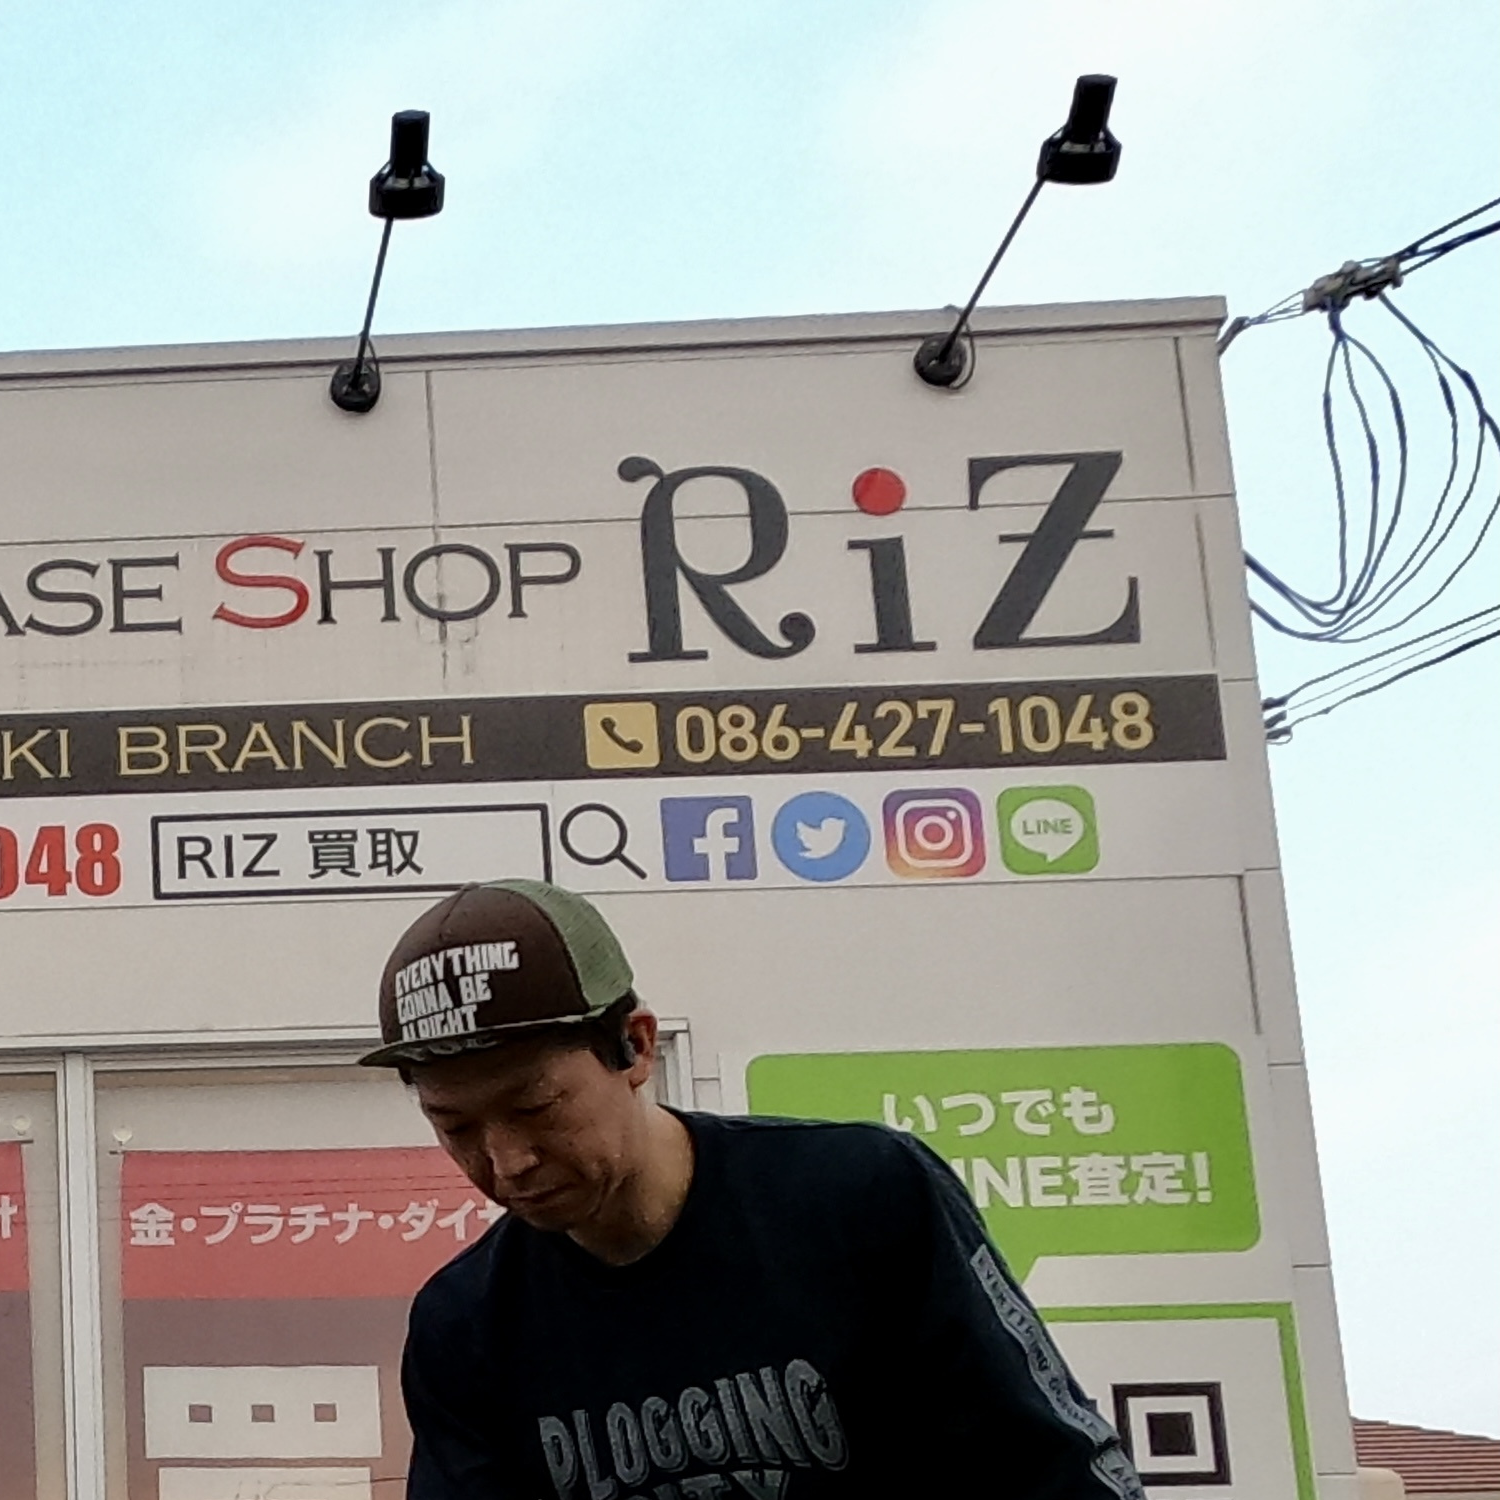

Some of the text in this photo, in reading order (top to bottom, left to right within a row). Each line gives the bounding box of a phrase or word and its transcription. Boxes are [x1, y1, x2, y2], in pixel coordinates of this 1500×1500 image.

[212, 535, 581, 629] SHOP
[618, 451, 1141, 662] RiZ
[117, 715, 476, 777] BRANCH
[674, 691, 1153, 763] 086-427-1048
[176, 828, 423, 880] RIZ 買取
[1022, 818, 1073, 835] LINE
[395, 941, 519, 999] EVERYTHING
[396, 972, 492, 1025] GONNA BE
[883, 1086, 1115, 1136] いつでも
